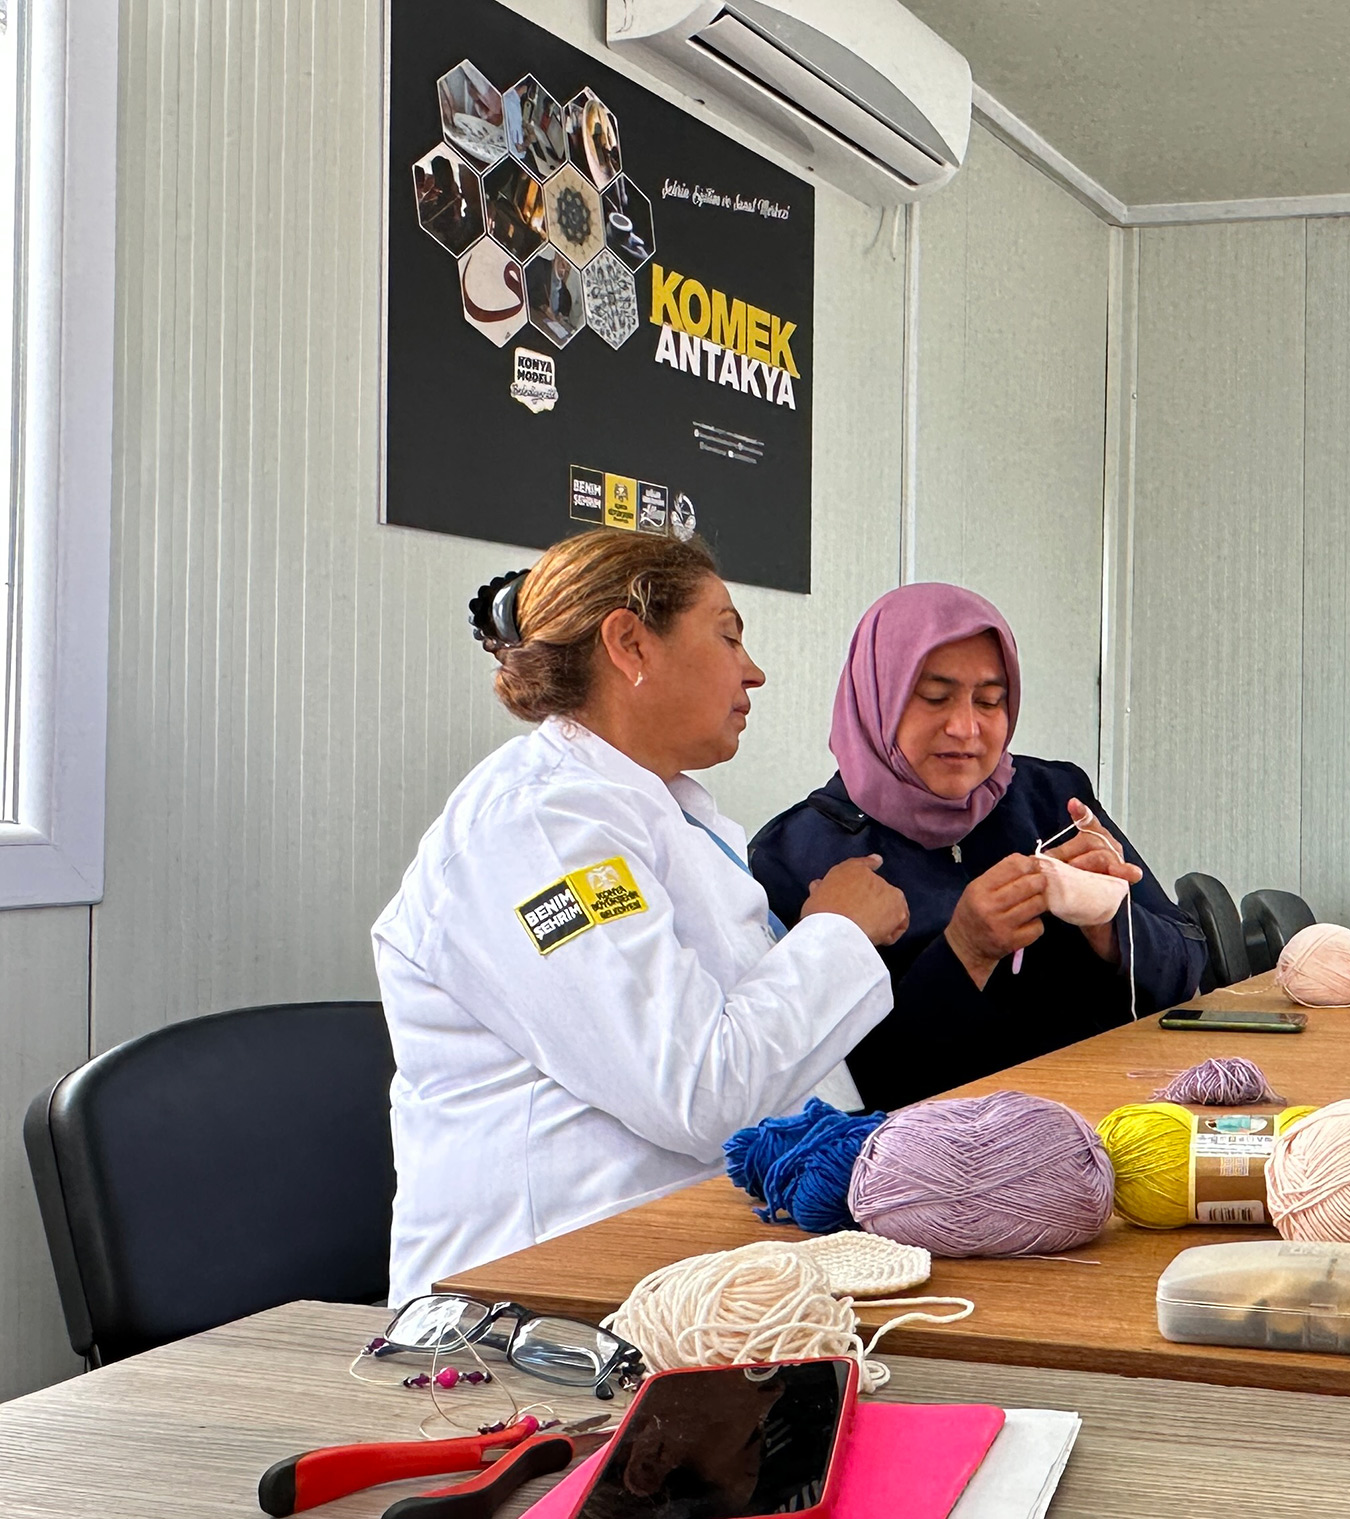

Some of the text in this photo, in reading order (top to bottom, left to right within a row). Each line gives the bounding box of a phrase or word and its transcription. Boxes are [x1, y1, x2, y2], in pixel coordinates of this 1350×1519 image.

[650, 262, 801, 379] KOMEK
[517, 356, 552, 374] KONYA
[655, 323, 796, 411] ANTAKYA
